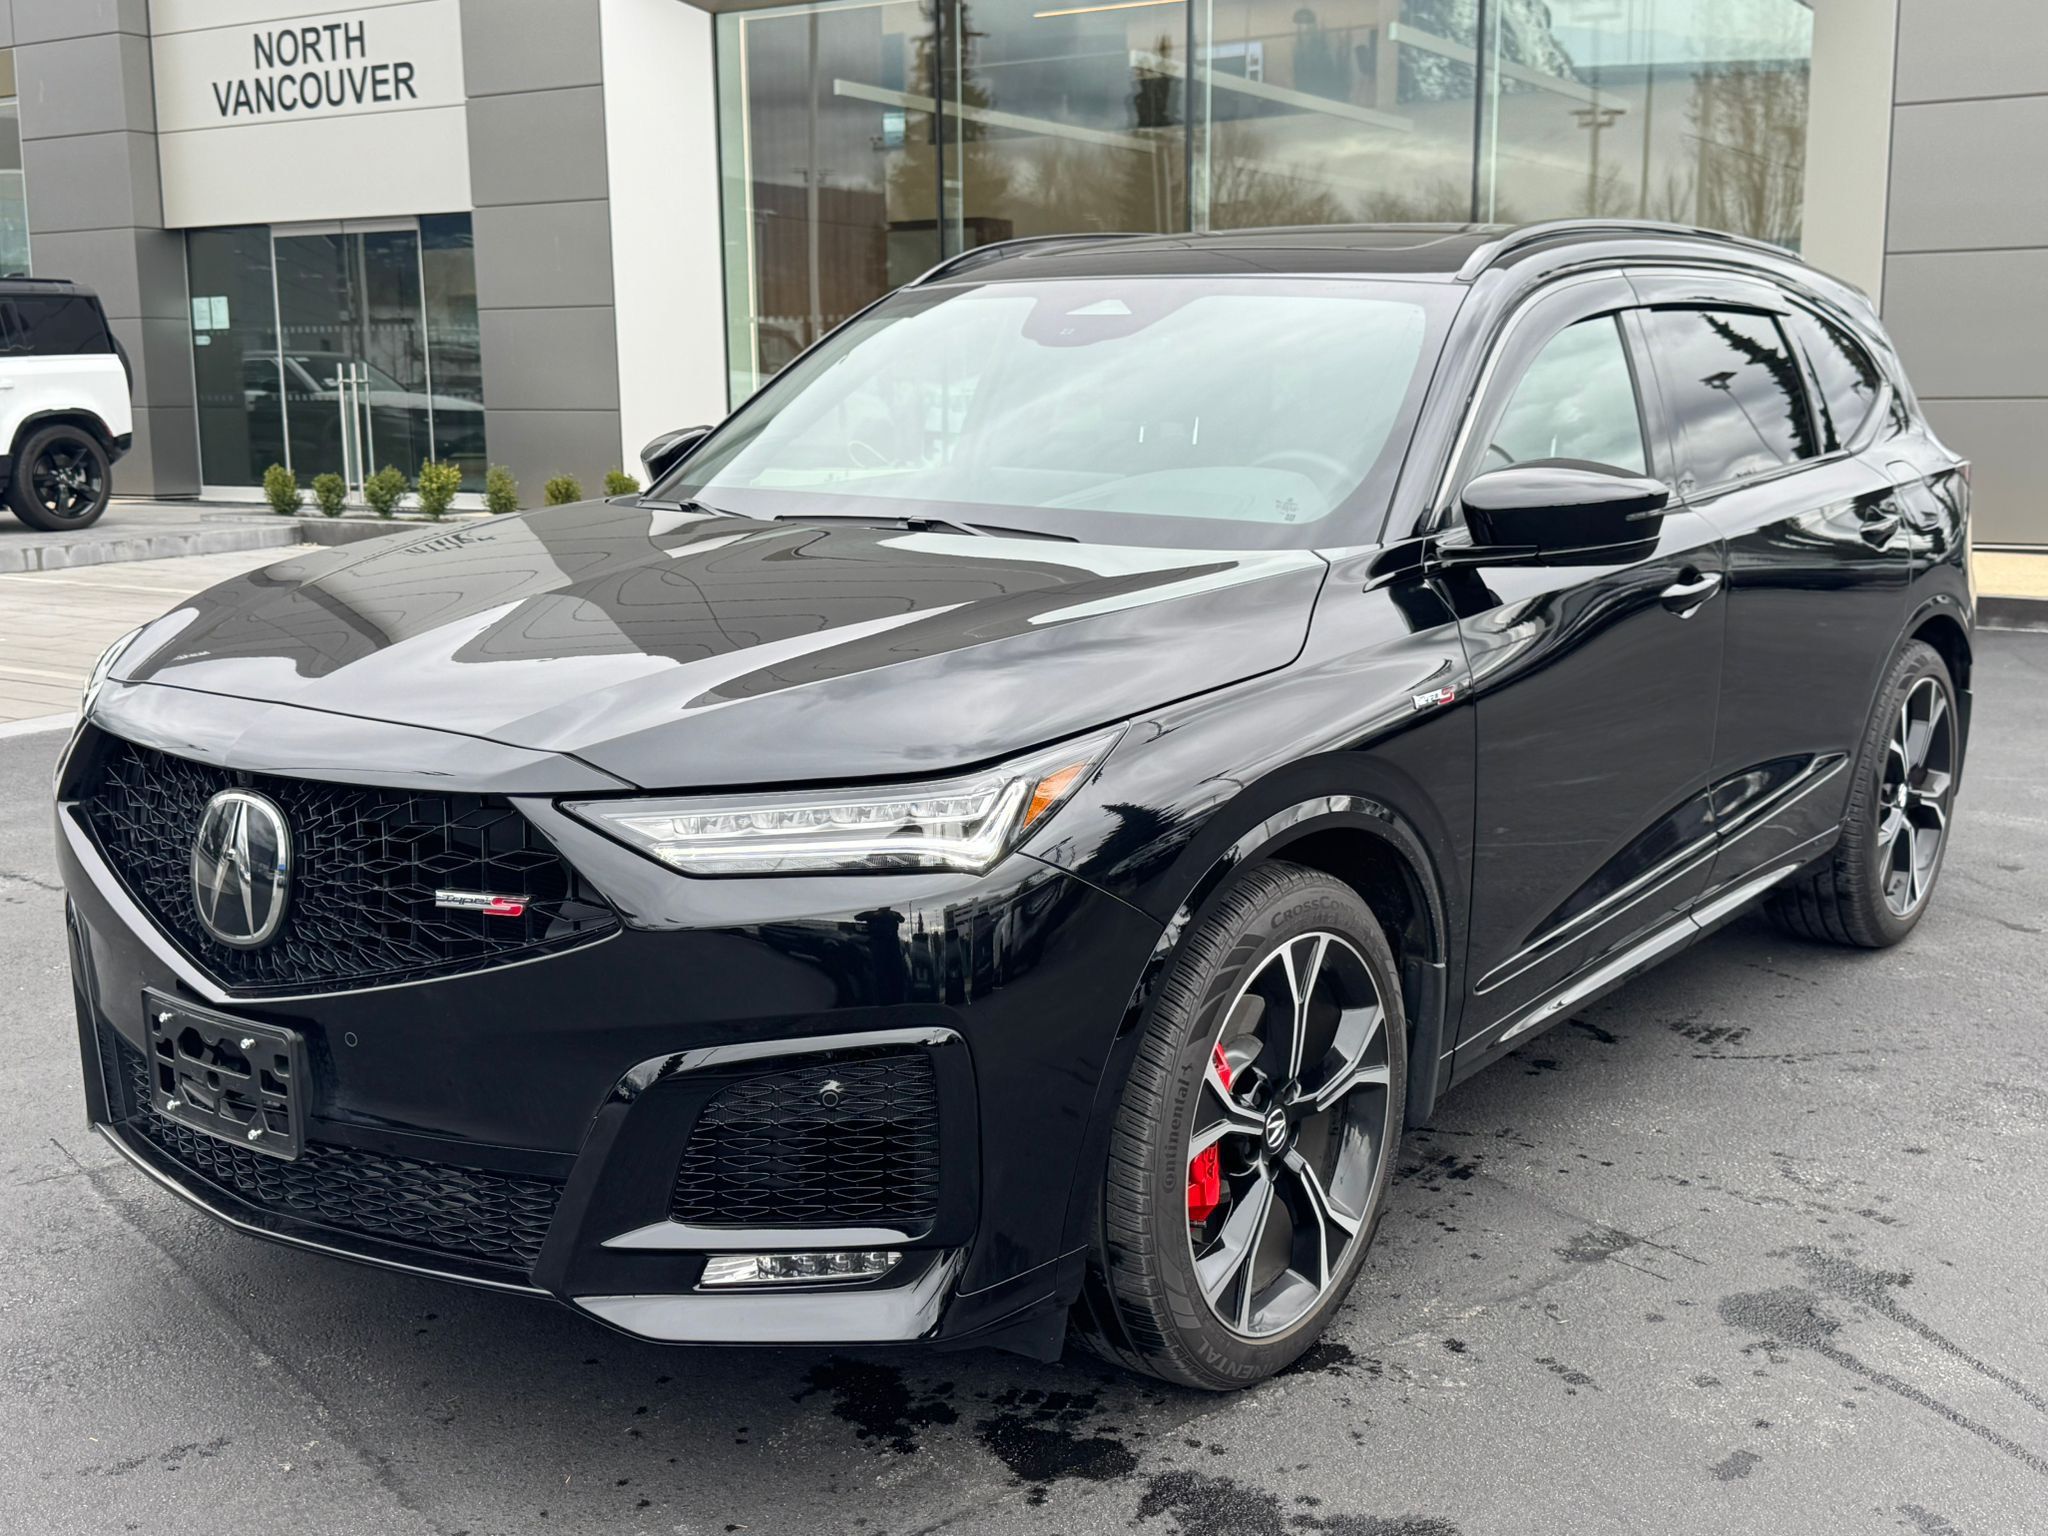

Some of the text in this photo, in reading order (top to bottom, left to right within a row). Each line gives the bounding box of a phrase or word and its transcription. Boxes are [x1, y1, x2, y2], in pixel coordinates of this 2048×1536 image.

[253, 20, 366, 70] NORTH
[212, 61, 418, 117] VANCOUVER
[483, 896, 529, 916] S
[1163, 1078, 1189, 1193] Continental
